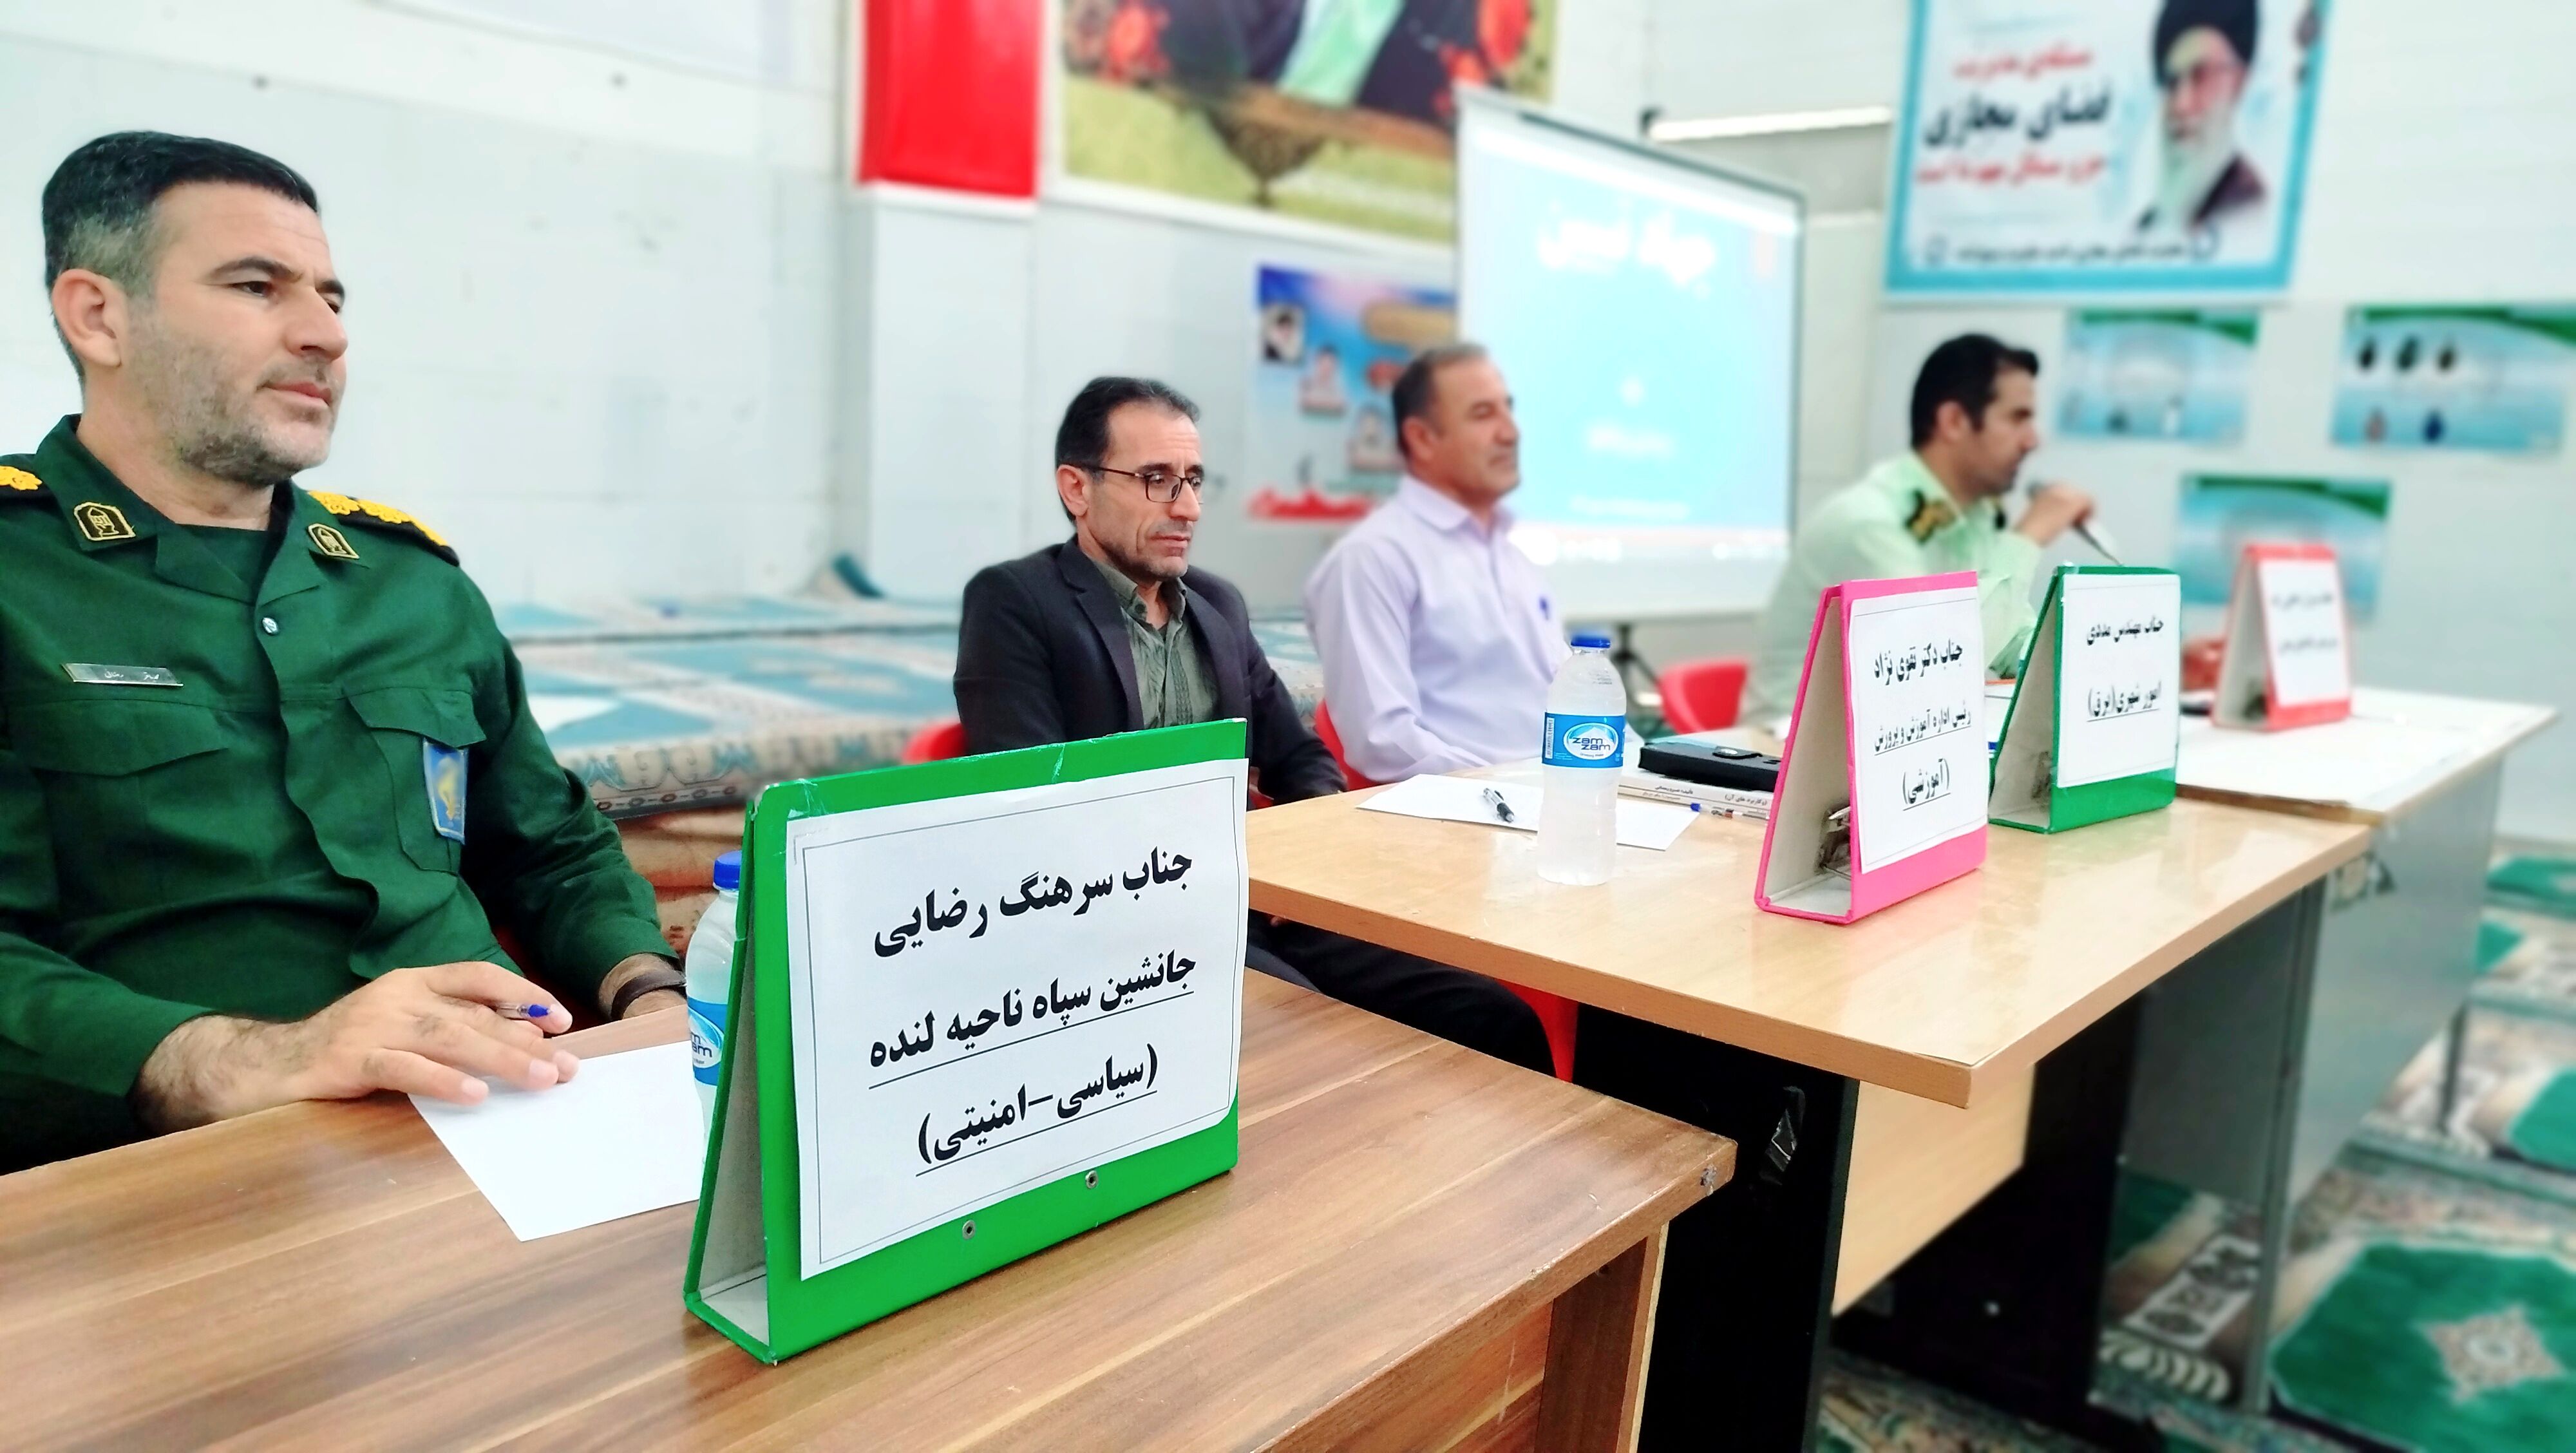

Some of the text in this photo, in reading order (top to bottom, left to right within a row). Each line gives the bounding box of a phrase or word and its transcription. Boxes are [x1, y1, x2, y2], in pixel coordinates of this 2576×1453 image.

[1874, 650, 1893, 686] نژاد
[1920, 642, 1938, 678] دکتر
[1940, 638, 1963, 670] جناب
[1906, 708, 1931, 742] آموزش
[1933, 707, 1950, 733] اداره
[1875, 725, 1899, 752] پرورش
[874, 846, 1193, 958] جناب سرهنگ رضایی
[869, 949, 1197, 1068] جانشین سپاه ناحیه لنده
